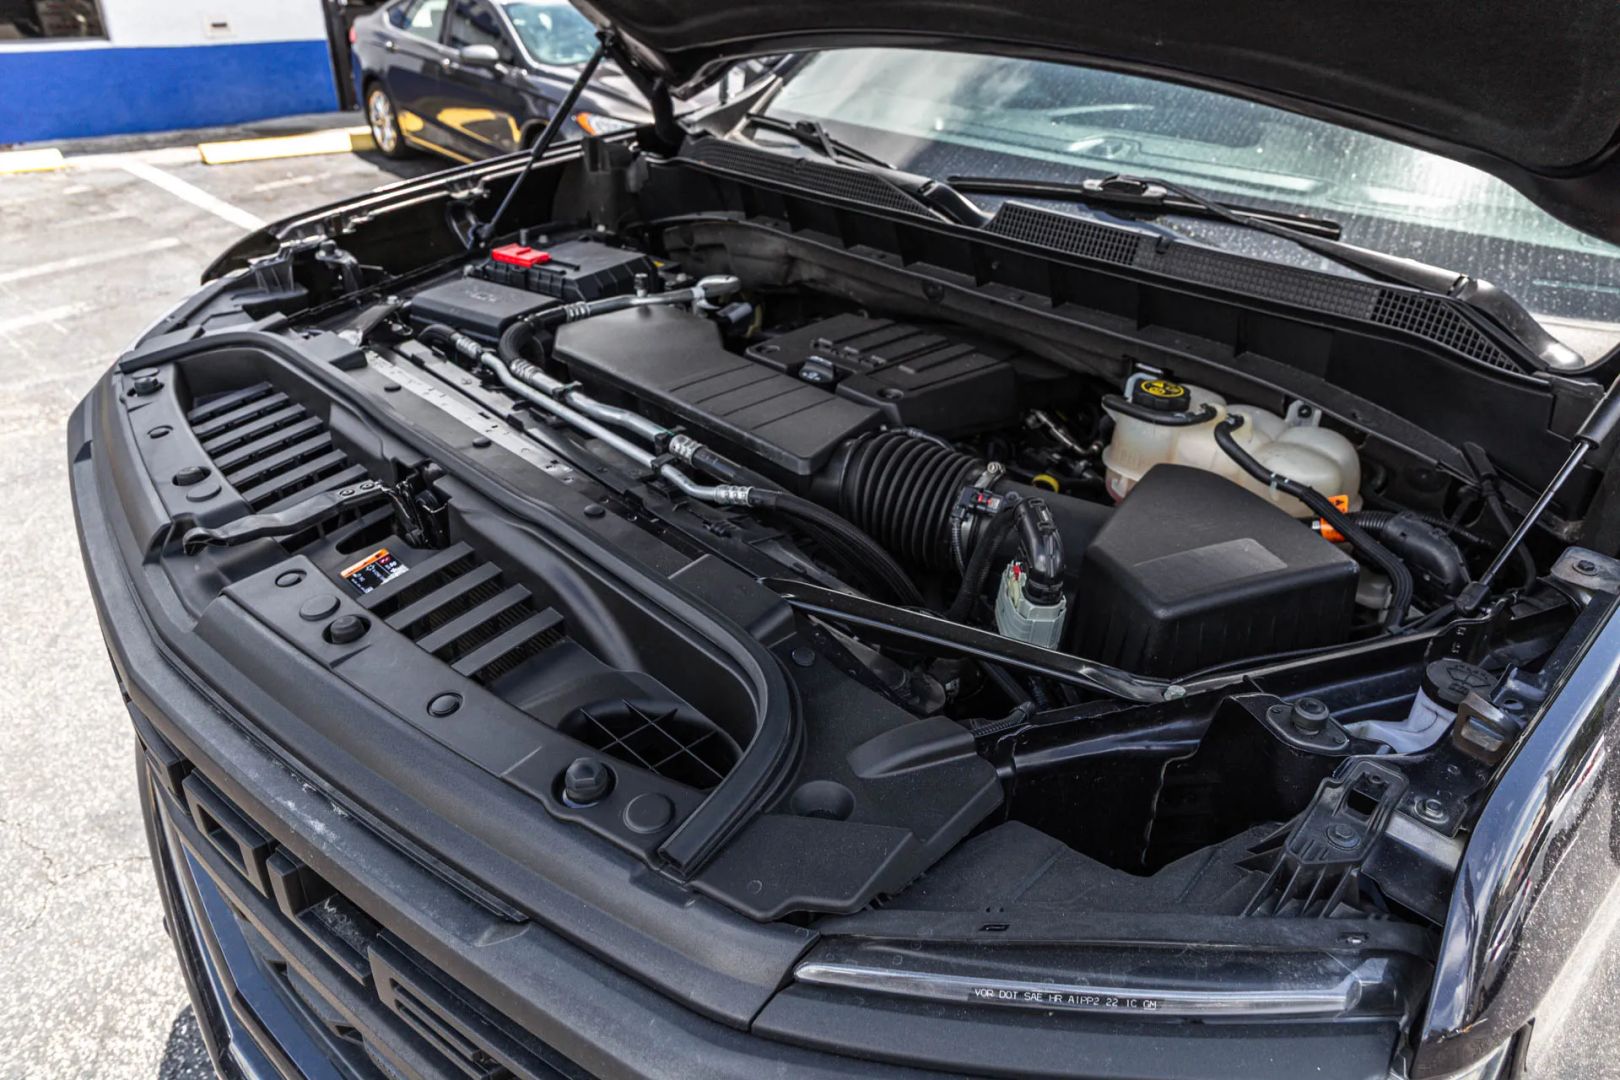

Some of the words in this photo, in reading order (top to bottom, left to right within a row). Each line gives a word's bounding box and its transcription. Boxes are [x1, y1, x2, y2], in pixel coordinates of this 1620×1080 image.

[974, 988, 994, 998] VOR
[999, 990, 1017, 999] DOT
[1024, 992, 1043, 1002] SAE
[1049, 994, 1063, 1003] HR
[1105, 998, 1118, 1007] 22
[1143, 1000, 1157, 1010] GM
